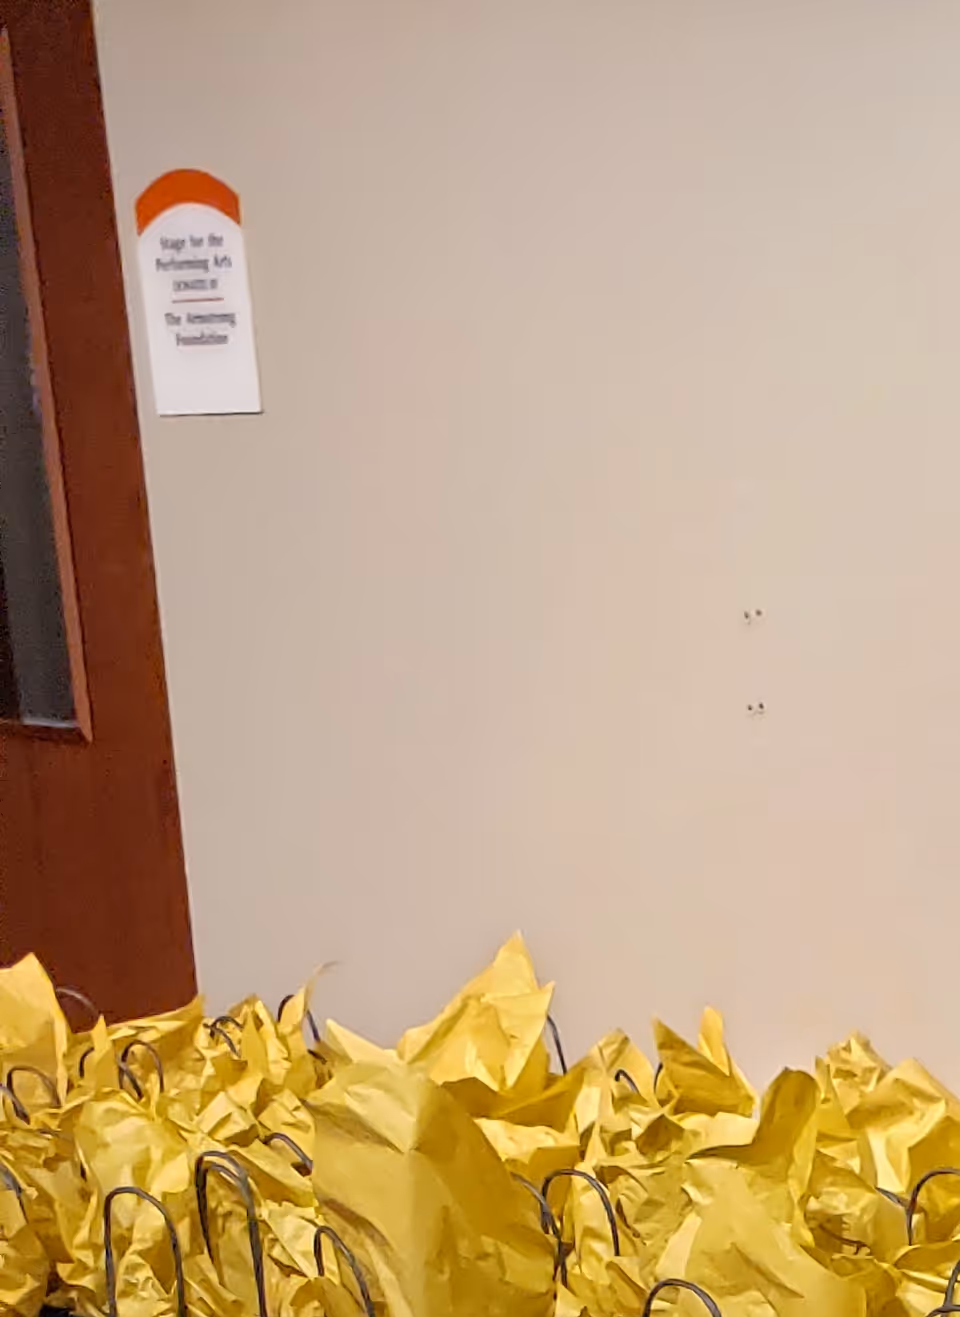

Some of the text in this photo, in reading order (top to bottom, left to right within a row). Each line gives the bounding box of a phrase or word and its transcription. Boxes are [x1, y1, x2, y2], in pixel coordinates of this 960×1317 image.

[160, 231, 224, 253] Stage for the
[156, 253, 232, 273] Performing Arts
[164, 311, 182, 327] The
